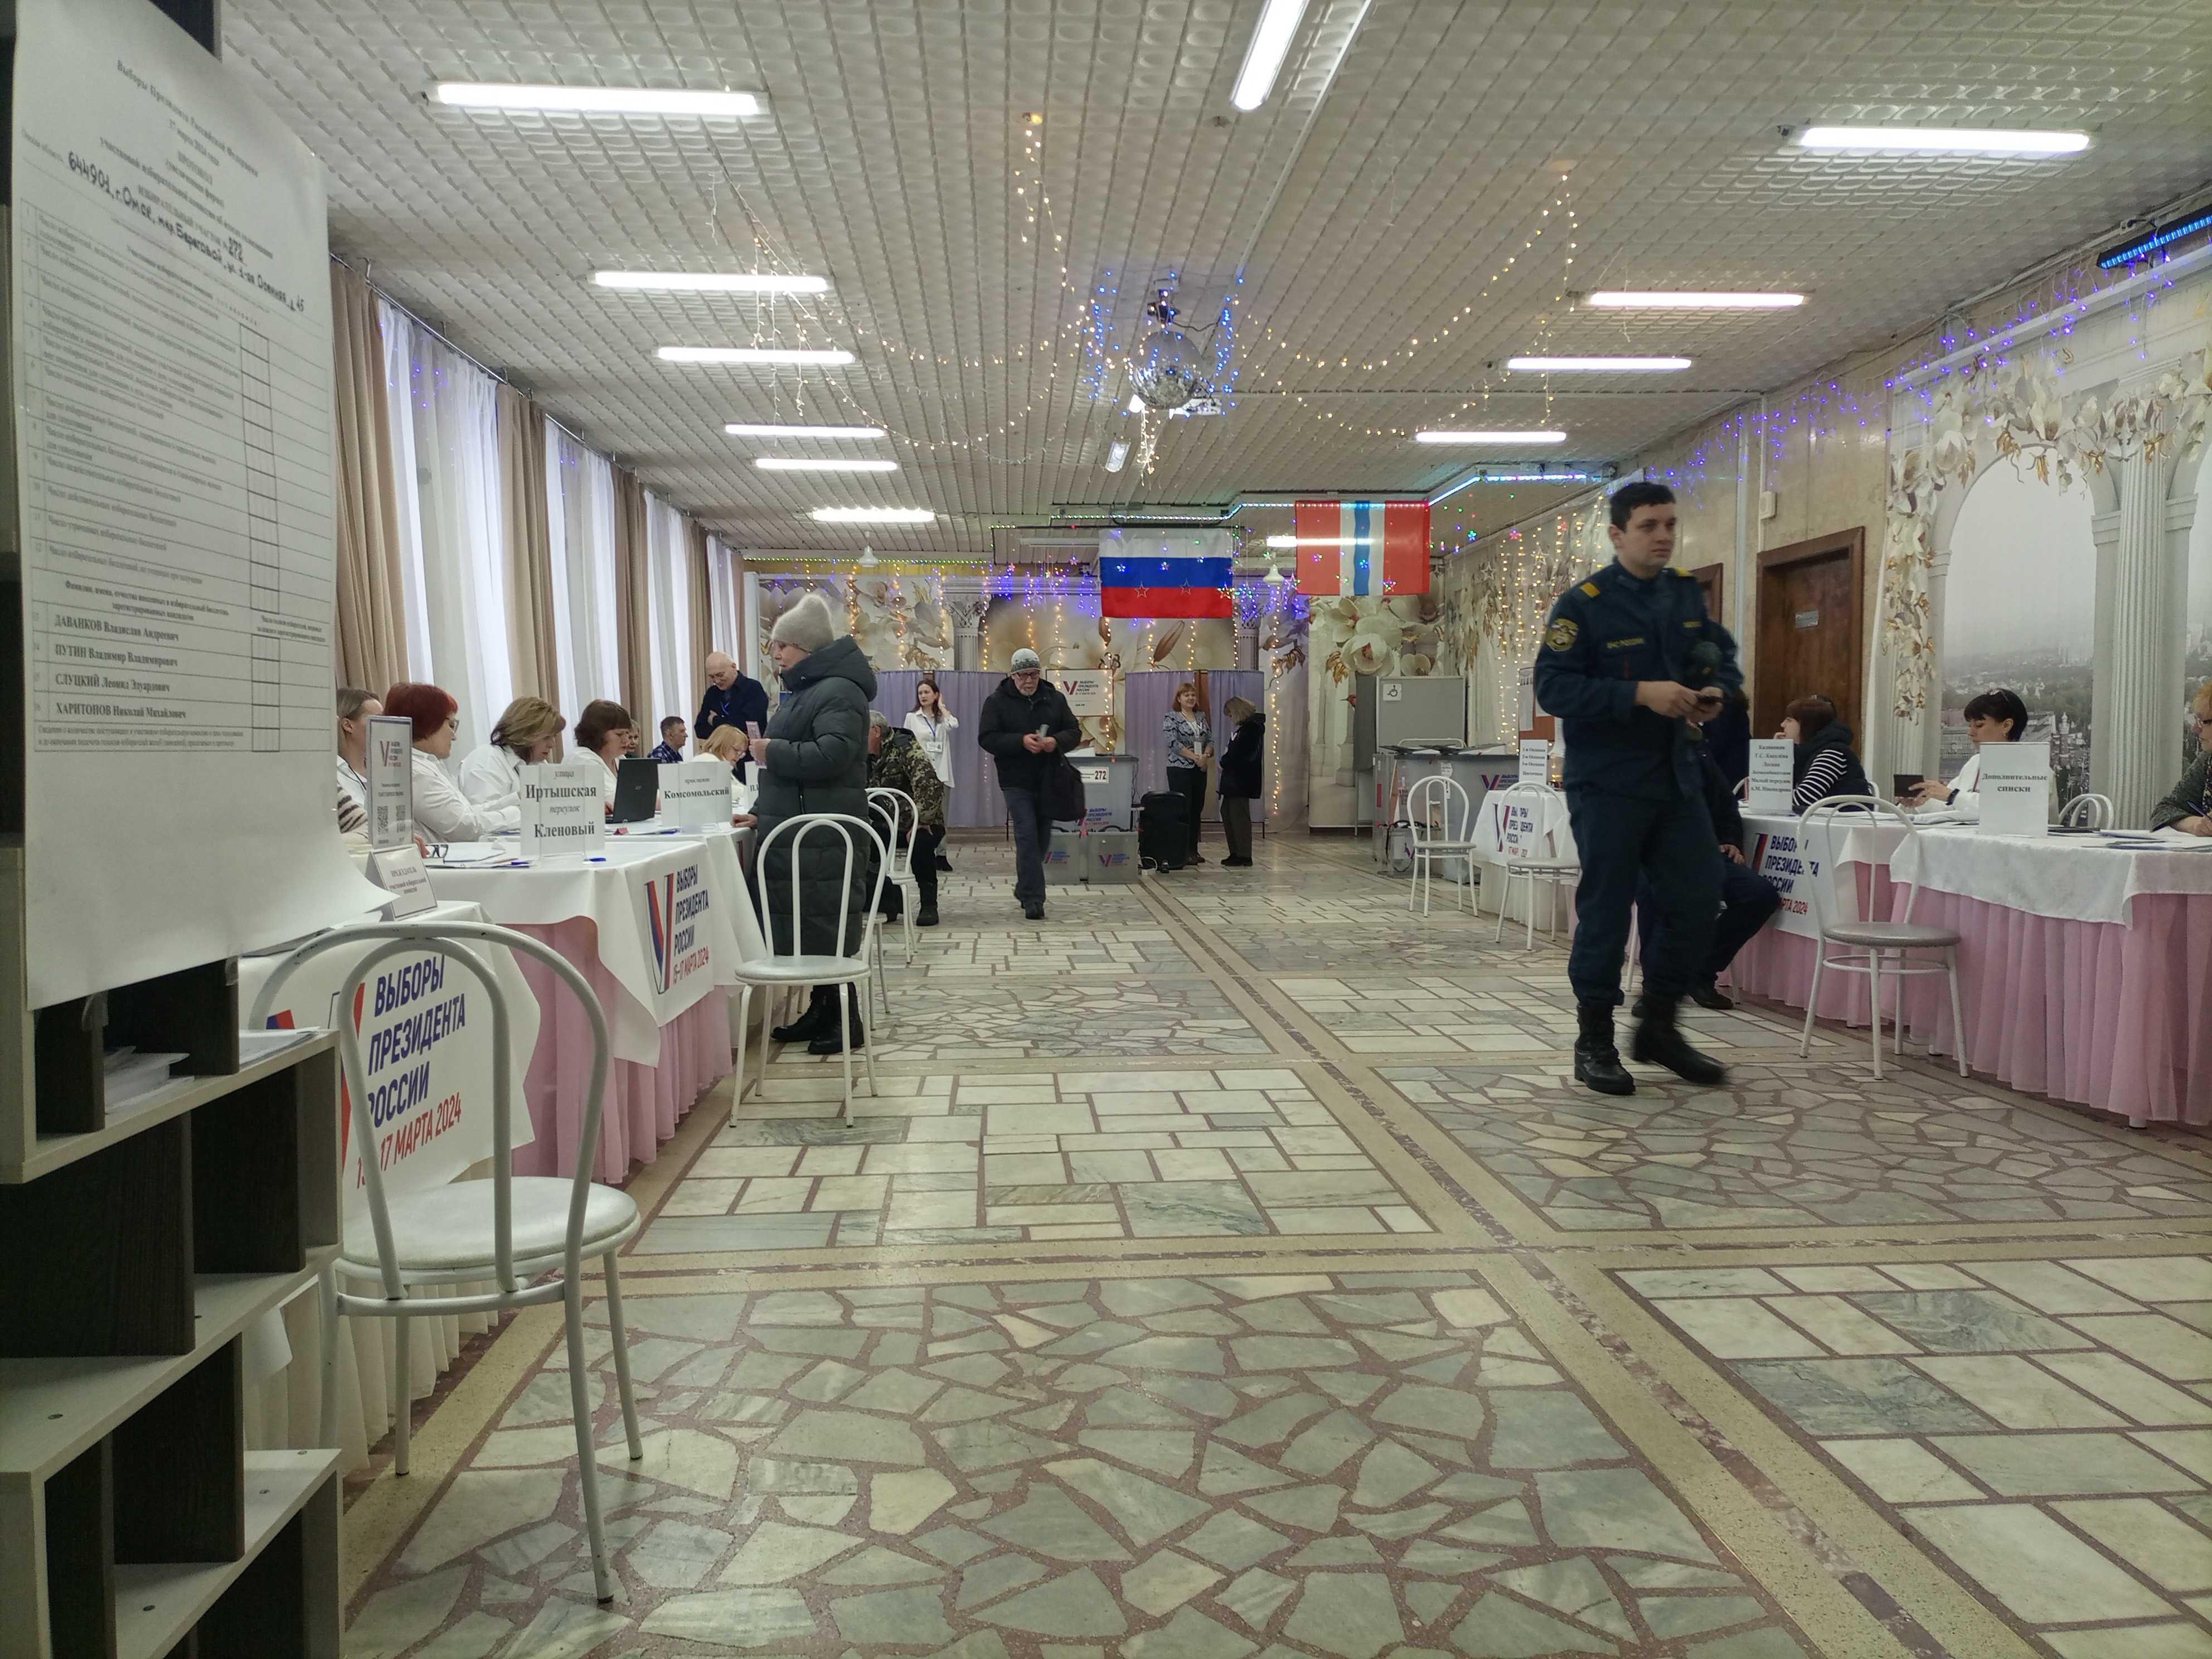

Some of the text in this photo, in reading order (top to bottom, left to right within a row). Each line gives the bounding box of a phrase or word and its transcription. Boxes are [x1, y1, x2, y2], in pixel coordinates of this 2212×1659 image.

[55, 614, 179, 642] ДАВАНКОВ Владислав Андреевич
[55, 643, 178, 668] ПУТИН Владимир Владимирович
[55, 673, 170, 693] СЛУЦКИЙ Леонид Эдуардович
[55, 702, 186, 719] ХАРИТОНОВ Николай Михайлович
[554, 770, 574, 779] улица
[1094, 770, 1107, 780] 272
[525, 784, 597, 802] Иртышская
[664, 787, 730, 799] Комсомольский
[549, 805, 580, 815] переулок
[533, 821, 595, 838] Кленовый
[676, 864, 698, 893] ВЫБОРЫ
[675, 889, 709, 925] ПРЕЗИДЕНТА
[674, 924, 695, 957] РОССИИ
[684, 952, 697, 979] МАРТА
[697, 945, 710, 969] 2024
[374, 954, 445, 1018] ВЫБОРЫ
[368, 992, 467, 1076] ПРЕЗИДЕНТА
[394, 1108, 433, 1166] МАРТА
[435, 1091, 462, 1138] 2024
